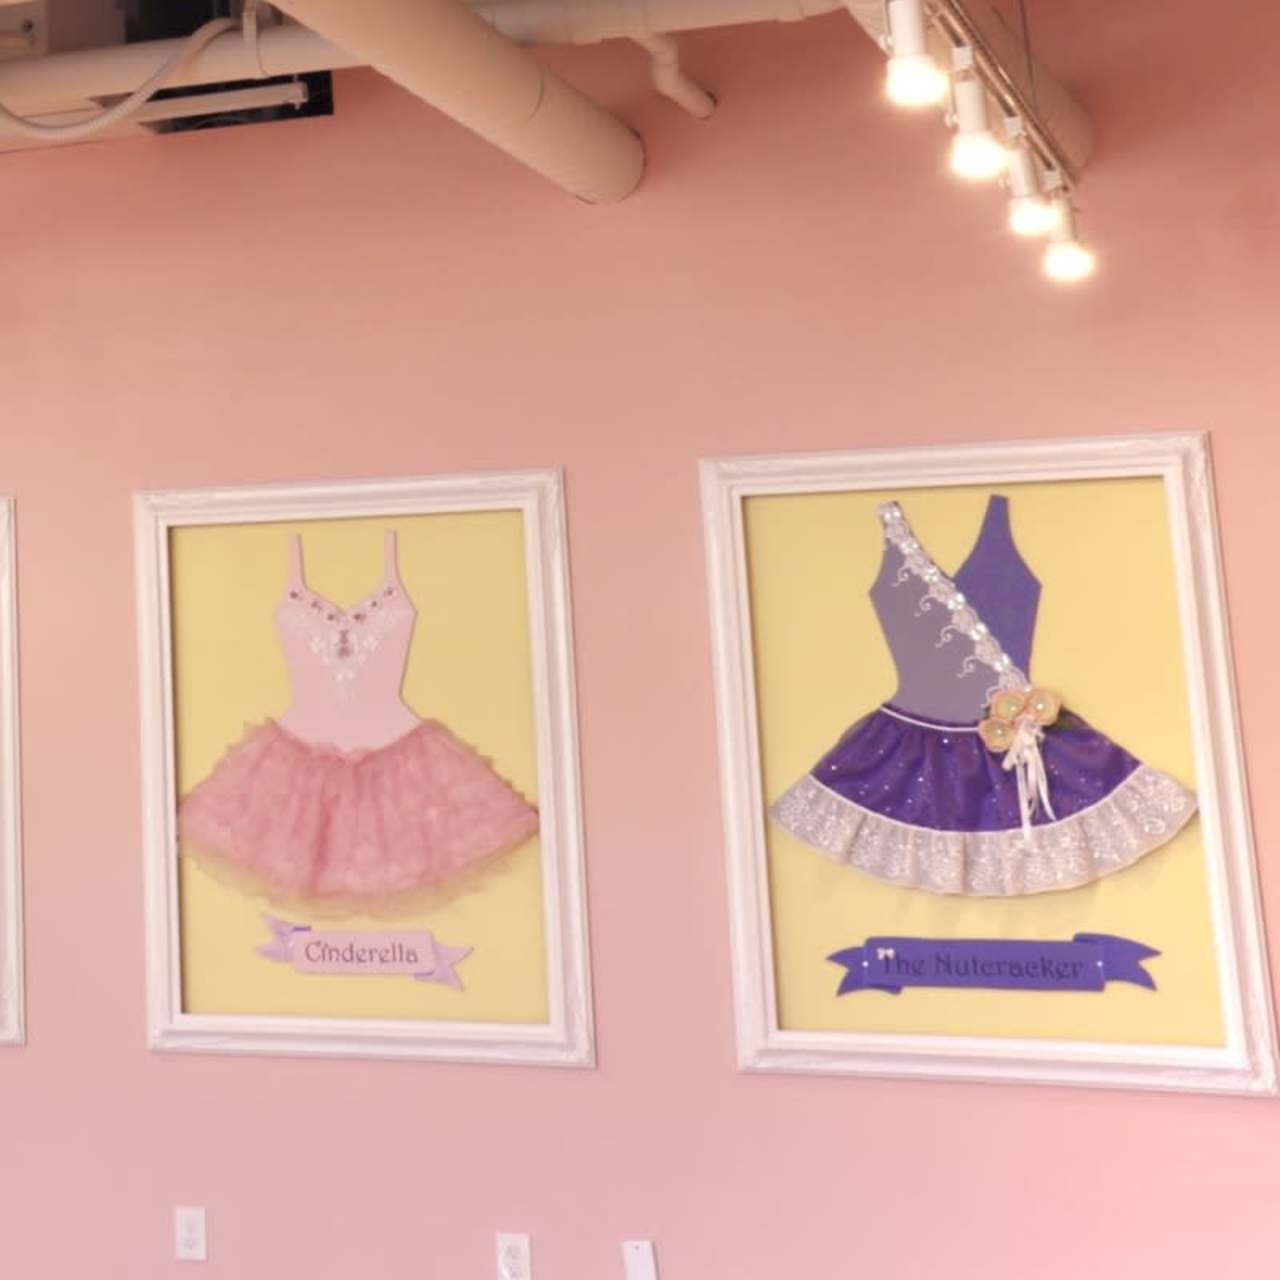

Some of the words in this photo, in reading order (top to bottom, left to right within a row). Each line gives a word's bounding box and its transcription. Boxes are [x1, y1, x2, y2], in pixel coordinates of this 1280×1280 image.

[304, 940, 419, 964] Cinderella
[880, 953, 925, 976] The
[933, 953, 1085, 980] Nutcracker
